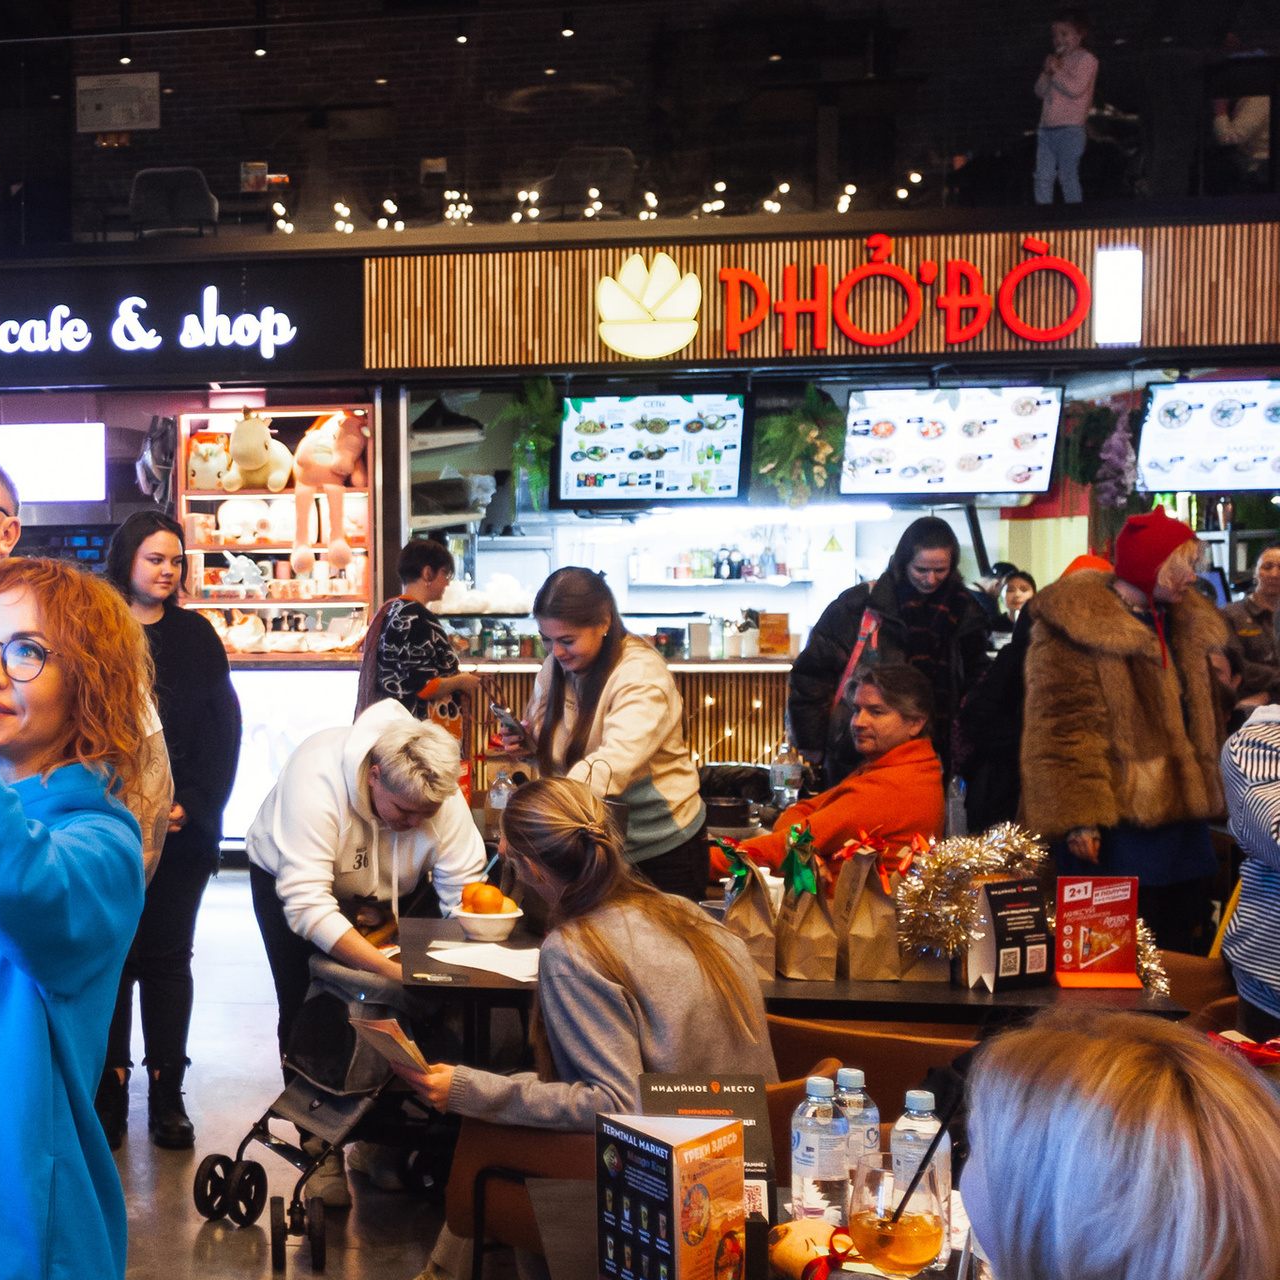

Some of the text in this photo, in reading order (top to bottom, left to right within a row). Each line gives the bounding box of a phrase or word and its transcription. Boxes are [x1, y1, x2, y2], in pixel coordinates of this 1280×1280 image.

[111, 296, 163, 351] &
[179, 285, 298, 359] shop
[1069, 886, 1089, 898] 2+1
[650, 1083, 756, 1094] МИДИЙНОЕ МЕСТО
[603, 1123, 669, 1160] TERMINAL MARKET
[711, 1131, 738, 1153] ЗДЕСЬ
